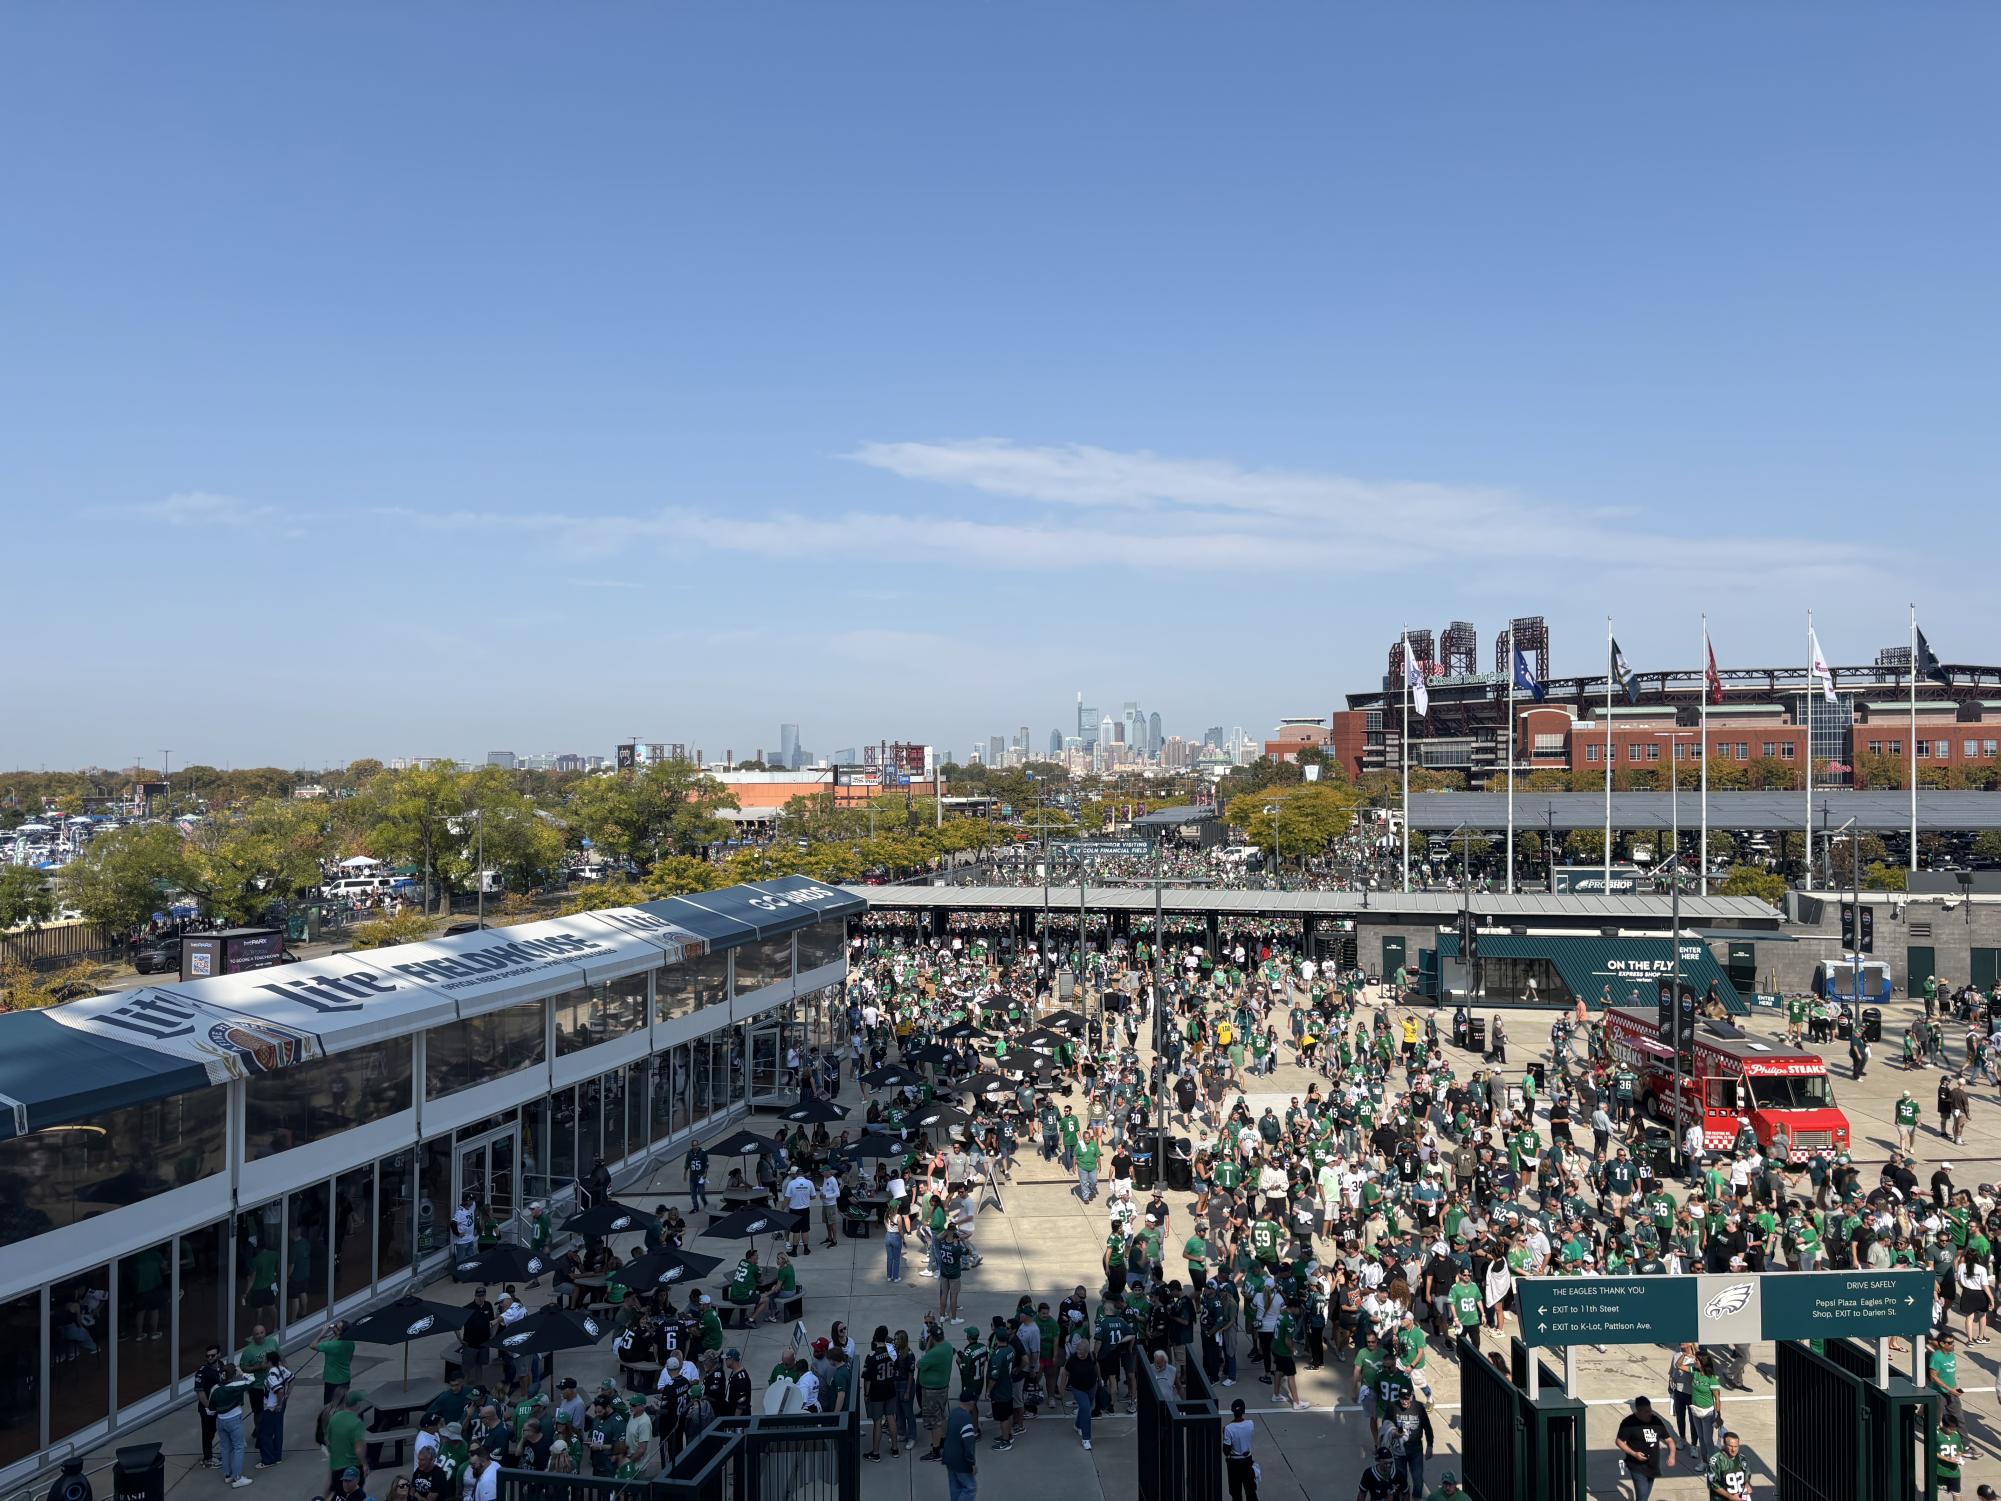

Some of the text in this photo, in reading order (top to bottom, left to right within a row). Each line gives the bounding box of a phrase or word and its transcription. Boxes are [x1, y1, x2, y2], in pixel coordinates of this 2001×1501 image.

[748, 895, 790, 911] GO
[1679, 946, 1702, 954] ENTER
[391, 933, 602, 984] FIELDHOUSE
[1607, 960, 1675, 971] ON THE FLY
[440, 978, 480, 991] OFFICIAL
[252, 971, 397, 1014] Lite
[1757, 994, 1775, 1002] ENTER
[1793, 1004, 1799, 1014] 6
[1296, 1012, 1301, 1020] 2
[1613, 1043, 1643, 1067] STEAKS
[1748, 1064, 1827, 1076] Philips STEAKS
[1619, 1080, 1631, 1089] 36
[1477, 1086, 1482, 1097] 1
[1360, 1105, 1371, 1116] 20
[1068, 1121, 1075, 1132] 6
[1524, 1137, 1534, 1149] 91
[1314, 1149, 1326, 1160] 26
[1404, 1162, 1412, 1174] 9
[1639, 1166, 1652, 1179] 62
[1225, 1170, 1231, 1186] 1
[1615, 1168, 1629, 1181] 11
[1492, 1206, 1506, 1222] 62
[1652, 1202, 1669, 1217] 26
[1710, 1222, 1716, 1236] 1
[1255, 1229, 1271, 1247] 59
[940, 1251, 954, 1264] 25
[1552, 1286, 1645, 1296] THE EAGLES THANK YOU
[1846, 1281, 1897, 1290] DRIVE SAFELY
[1461, 1297, 1476, 1313] 62
[1552, 1304, 1620, 1314] EXIT to 11th Steet
[1815, 1297, 1897, 1309] Pepsi Plaza Eagles Pro
[1835, 1309, 1852, 1318] EXIT
[1862, 1309, 1886, 1317] Darien
[1887, 1308, 1897, 1316] St.
[1552, 1322, 1652, 1331] EXIT to K-Lot, Pattison Ave.
[666, 1332, 677, 1350] 6
[1109, 1330, 1122, 1345] 11
[876, 1361, 894, 1381] 36
[1380, 1381, 1400, 1401] 92
[1725, 1471, 1745, 1494] 92
